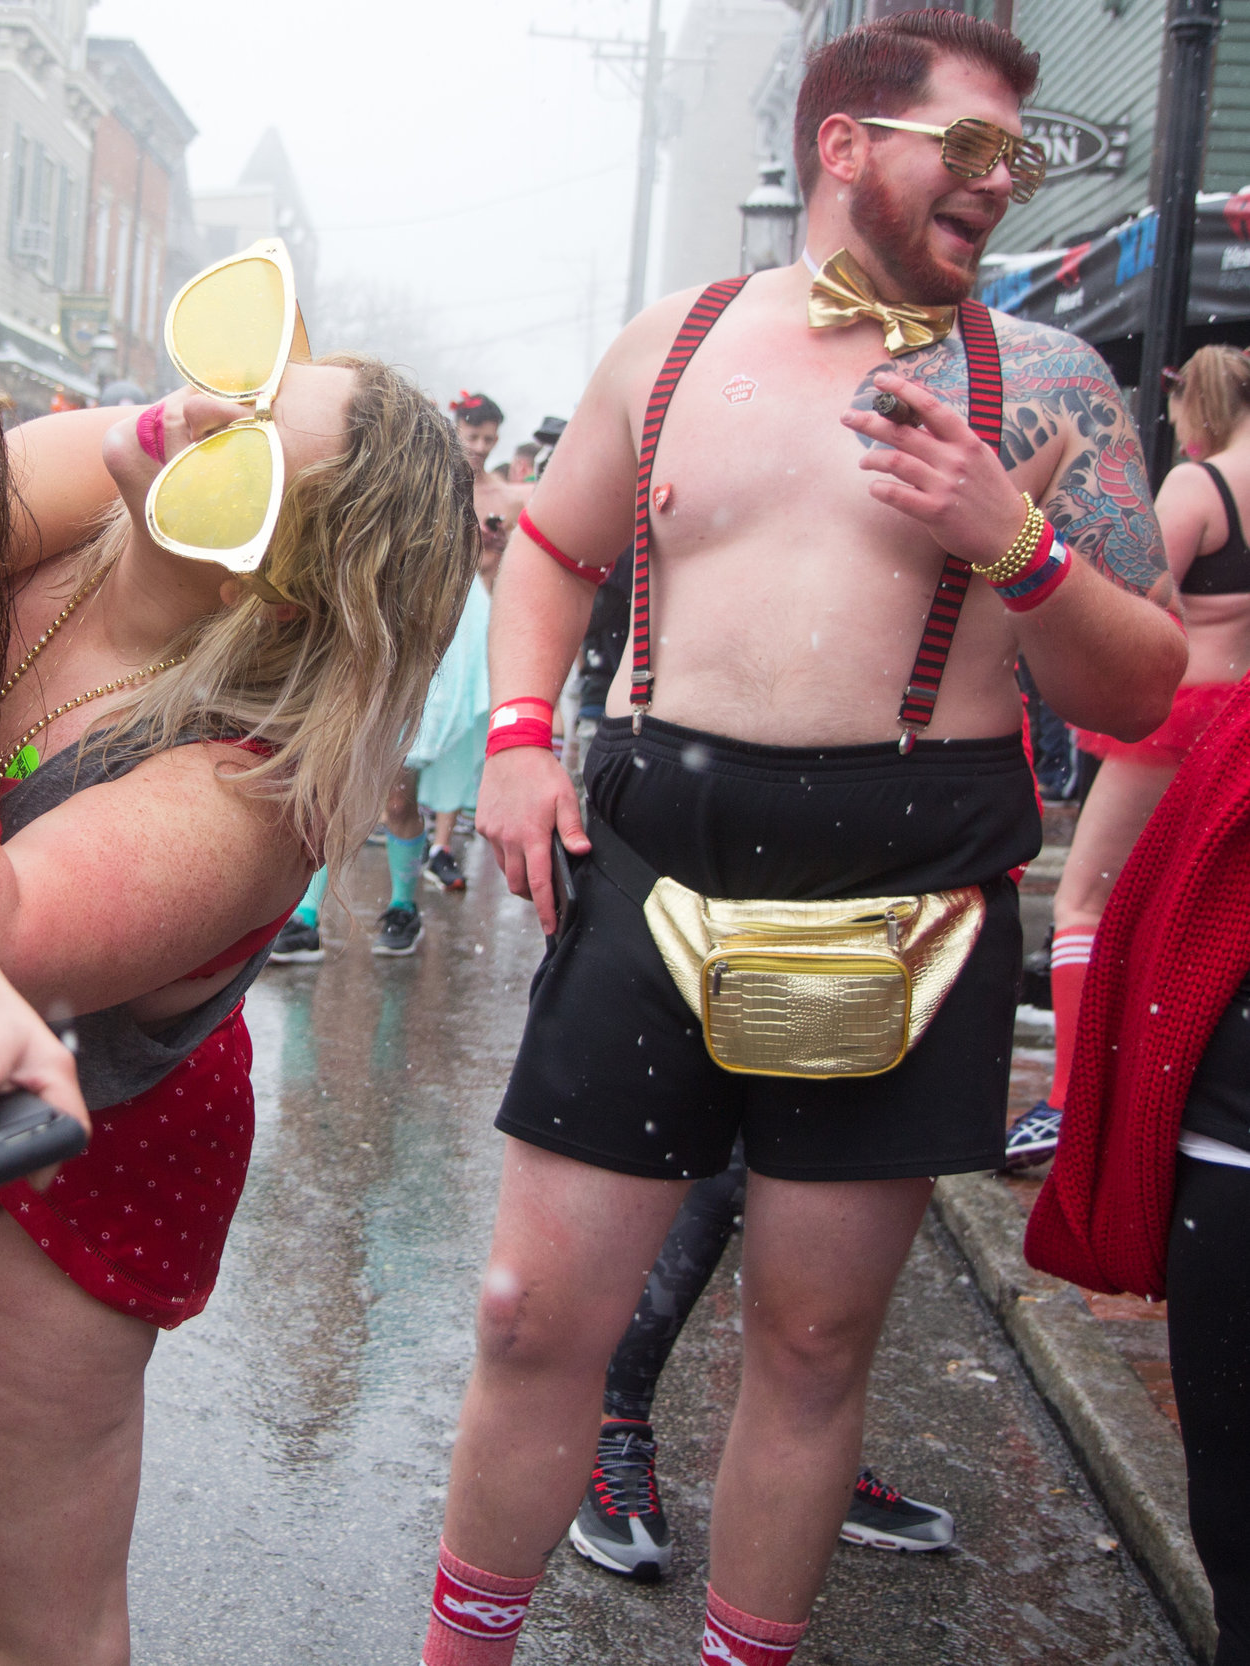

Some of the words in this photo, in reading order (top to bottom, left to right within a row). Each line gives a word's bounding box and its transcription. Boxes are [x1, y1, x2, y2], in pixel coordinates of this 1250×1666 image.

[1028, 135, 1079, 166] ON
[725, 383, 753, 394] cutie
[731, 391, 748, 402] pie
